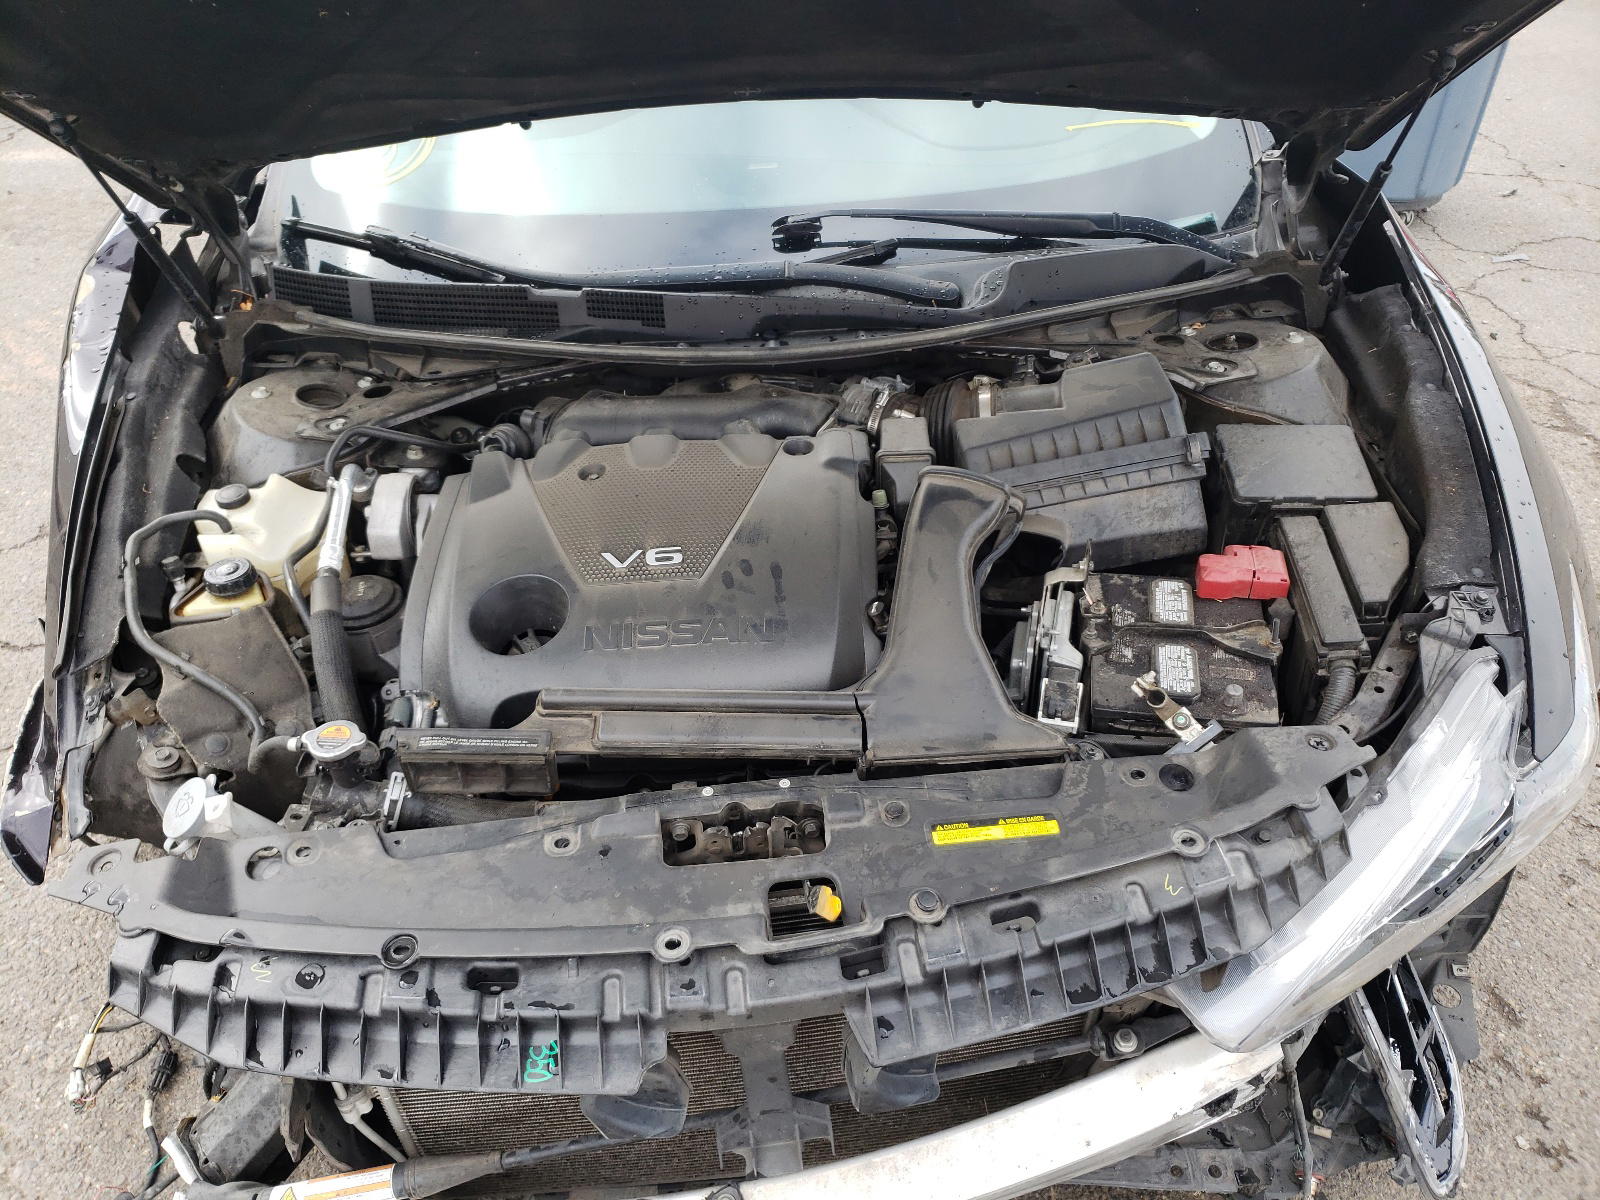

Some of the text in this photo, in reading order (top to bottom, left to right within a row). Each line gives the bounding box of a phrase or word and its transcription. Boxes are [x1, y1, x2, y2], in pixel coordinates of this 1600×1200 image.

[601, 546, 683, 569] V6
[584, 616, 775, 651] NISSAN
[943, 822, 969, 831] CAUTION
